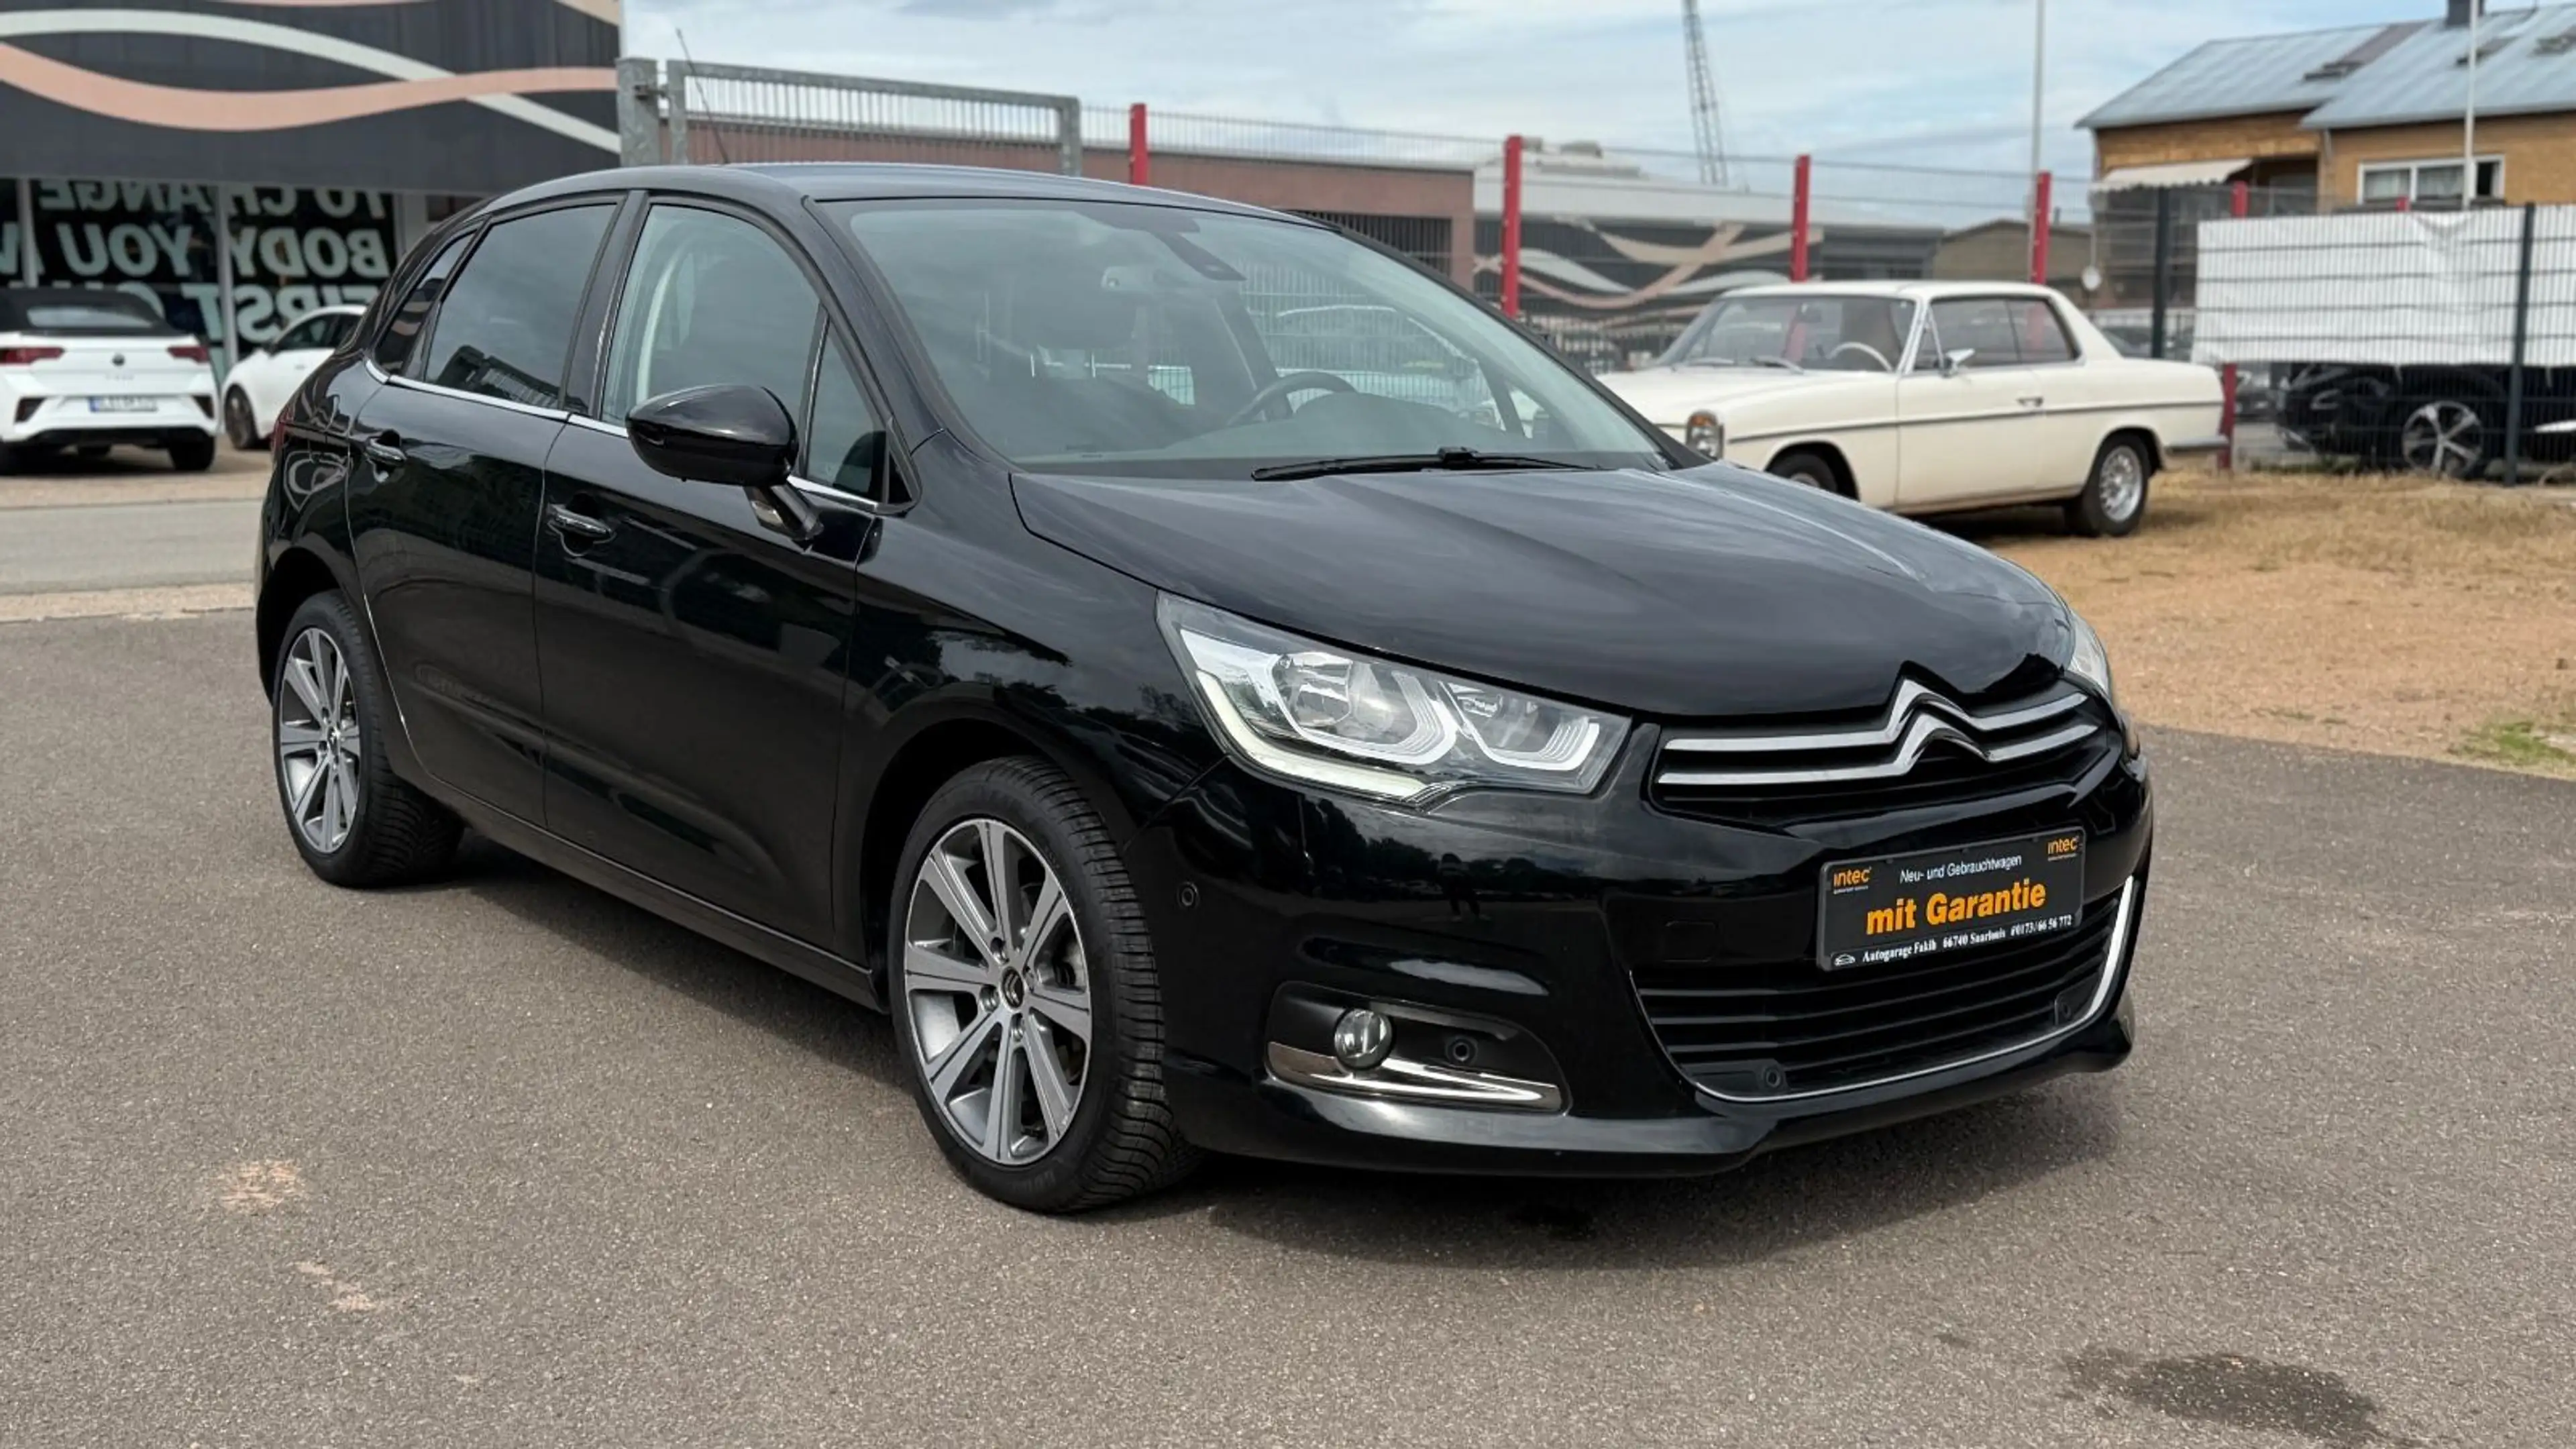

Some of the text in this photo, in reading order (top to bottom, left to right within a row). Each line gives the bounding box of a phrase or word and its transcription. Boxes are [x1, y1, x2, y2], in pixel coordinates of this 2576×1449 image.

[2047, 837, 2078, 854] intec
[1833, 867, 1870, 887] intec
[1900, 855, 2022, 883] Neu- und Gebrauchtwagen
[1866, 877, 2046, 935] mit Garantie
[1862, 945, 1912, 963] Autogarage
[1943, 932, 1968, 948] 66740
